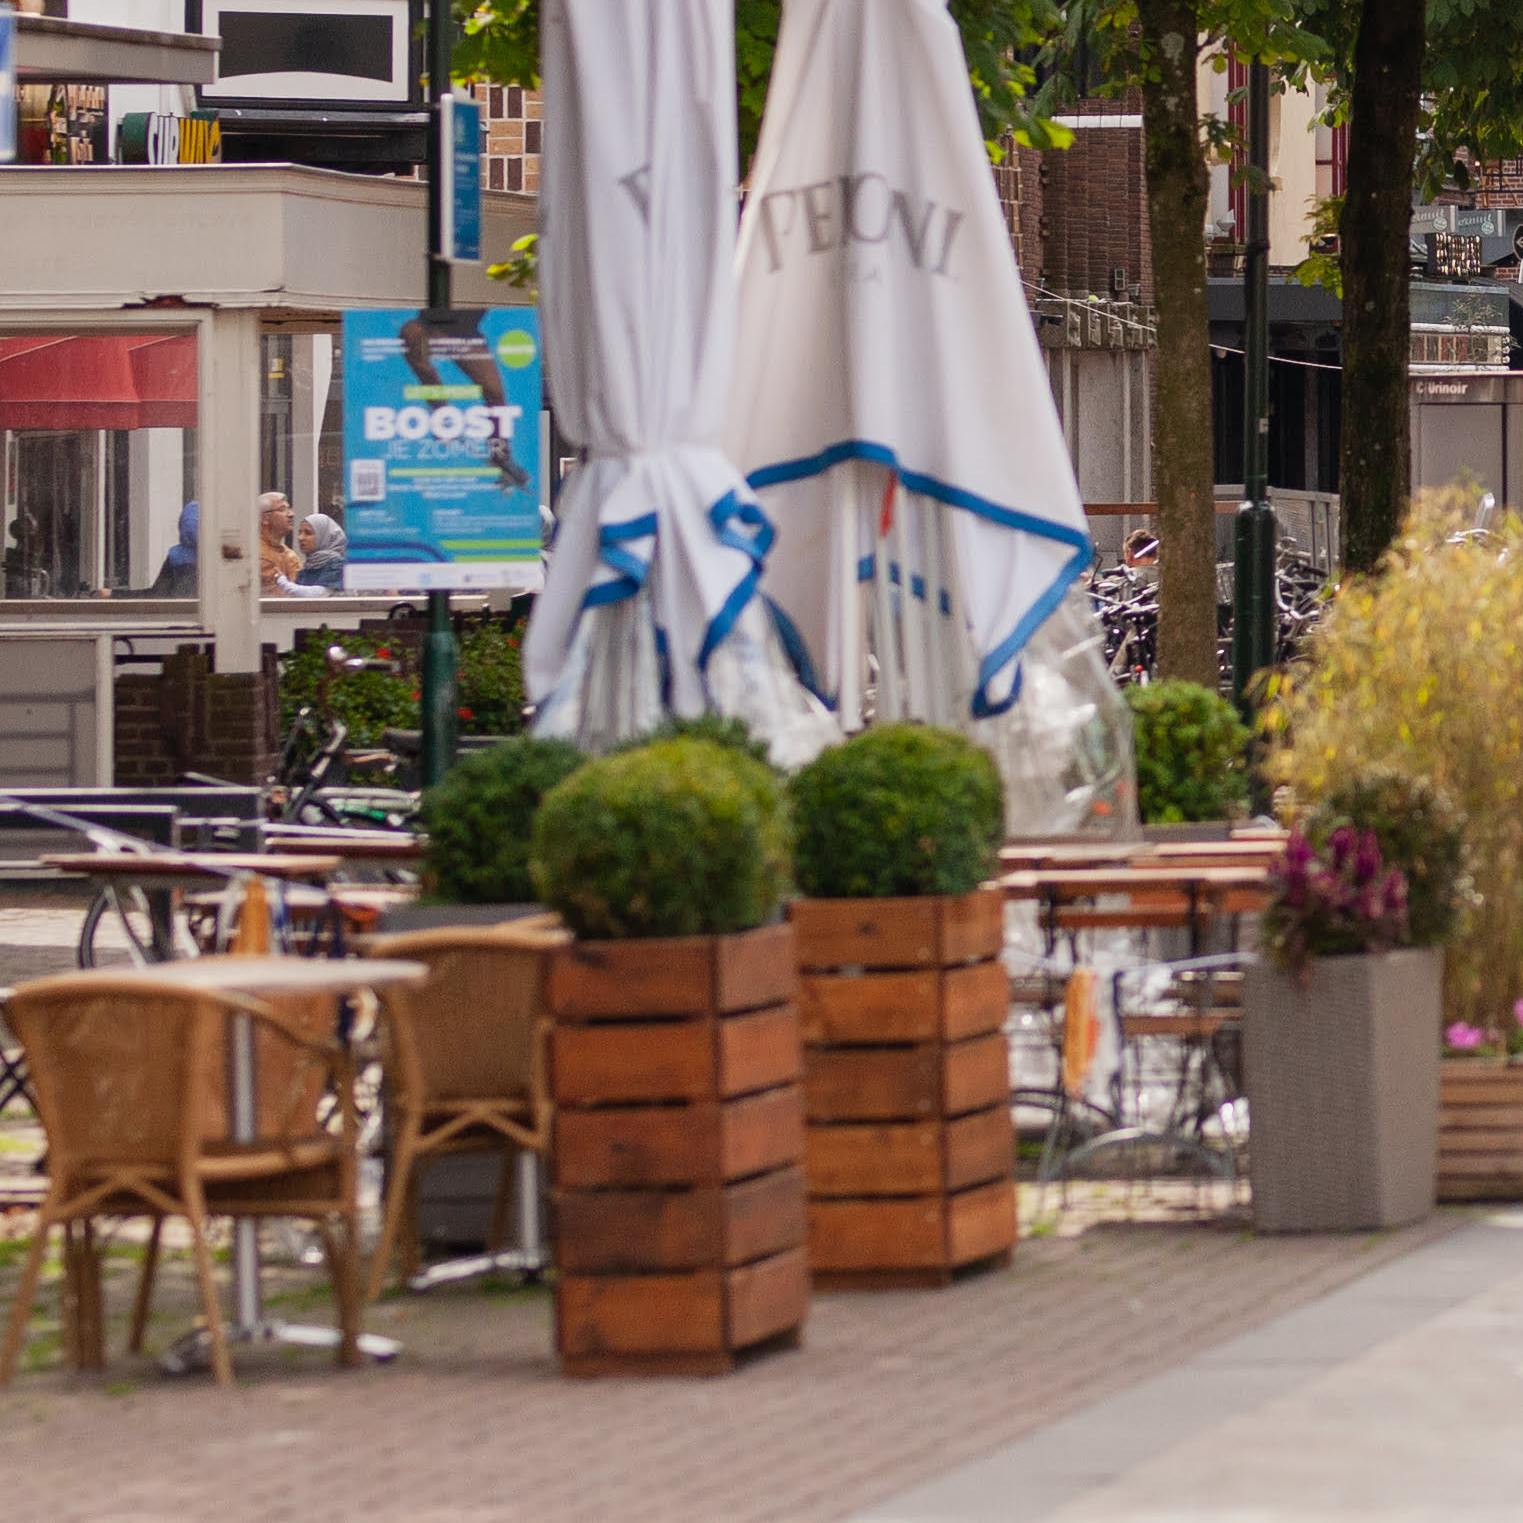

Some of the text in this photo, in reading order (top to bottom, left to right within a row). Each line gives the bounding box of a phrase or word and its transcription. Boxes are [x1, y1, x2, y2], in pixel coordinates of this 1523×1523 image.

[1428, 381, 1468, 395] Urinoir
[363, 404, 523, 441] BOOST
[386, 439, 508, 460] JE ZOMER
